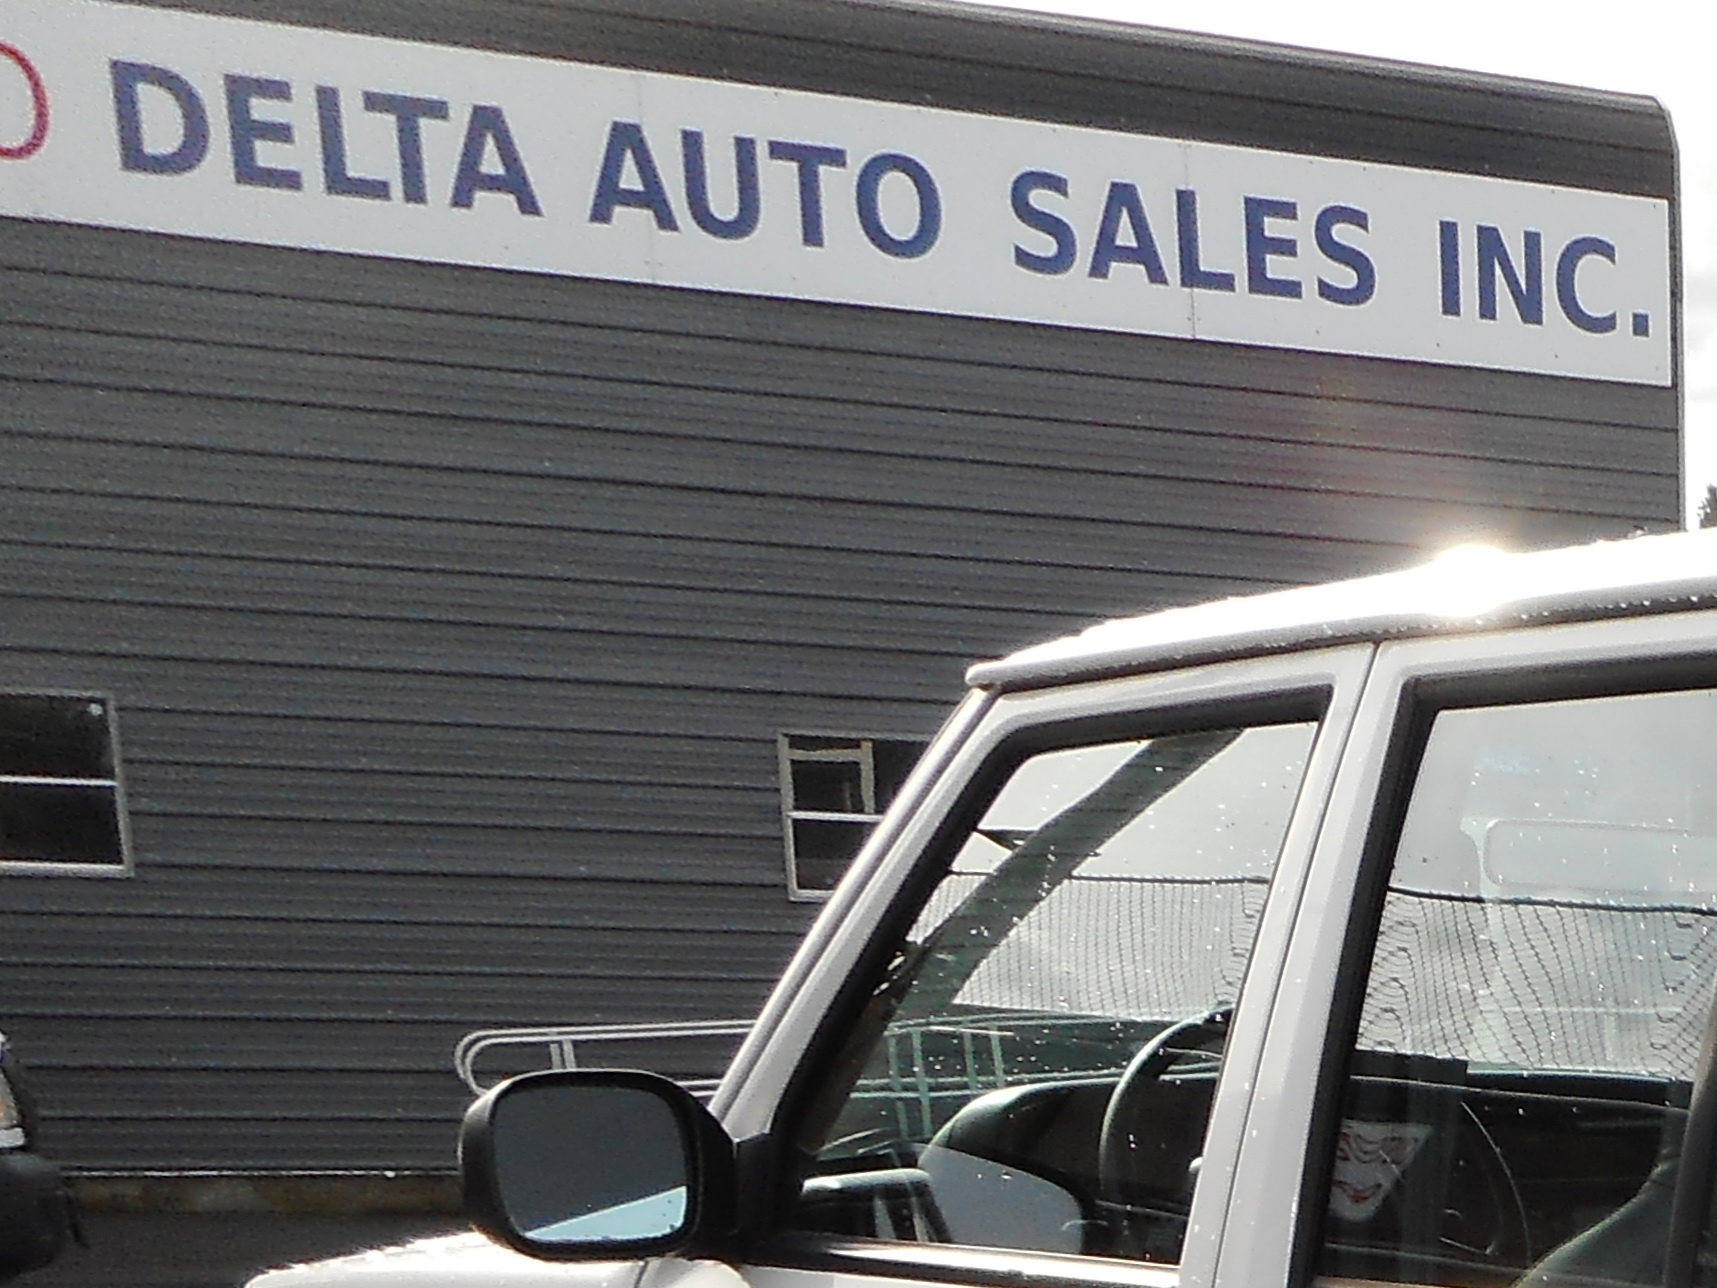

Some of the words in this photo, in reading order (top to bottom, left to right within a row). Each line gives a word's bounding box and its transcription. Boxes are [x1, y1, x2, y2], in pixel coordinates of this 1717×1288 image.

[110, 59, 543, 218] DELTA
[589, 121, 943, 260] AUTO
[1009, 170, 1377, 306] SALES
[1439, 219, 1651, 338] INC.
